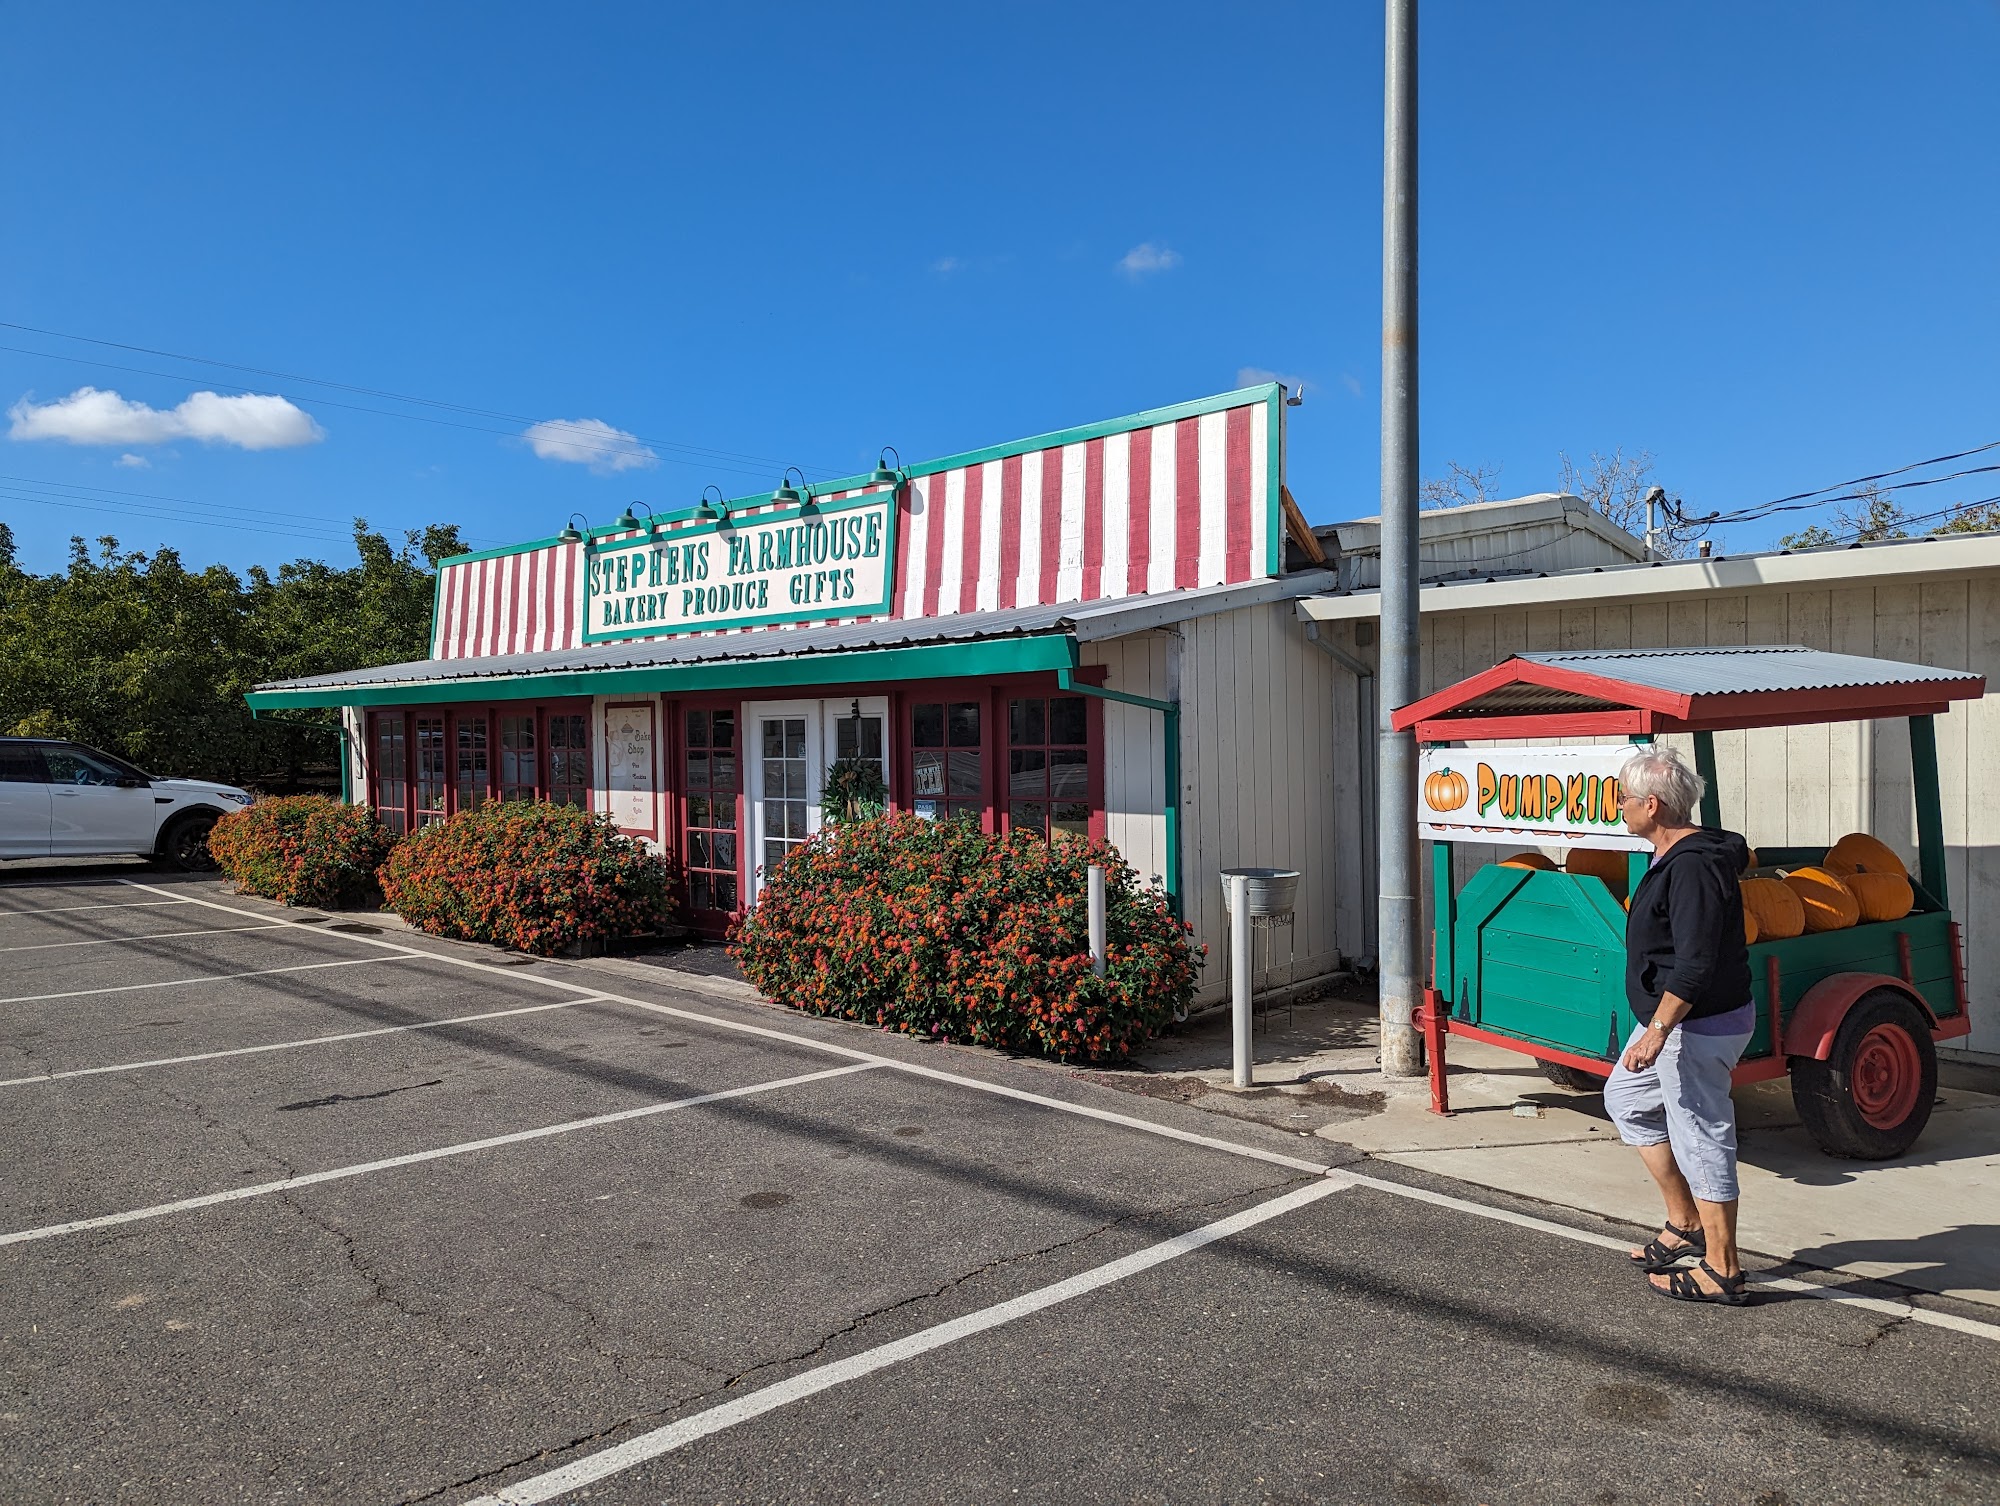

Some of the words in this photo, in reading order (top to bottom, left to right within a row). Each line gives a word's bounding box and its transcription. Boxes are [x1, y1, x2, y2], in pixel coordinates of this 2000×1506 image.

[589, 541, 709, 596] STEPHENS
[727, 511, 882, 576] FARMHOUSE
[602, 592, 668, 626] BAKERY
[681, 579, 769, 617] PRODUCE
[789, 568, 855, 605] GIFTS
[628, 743, 645, 756] Shop
[1477, 762, 1627, 826] PUMPKIN
